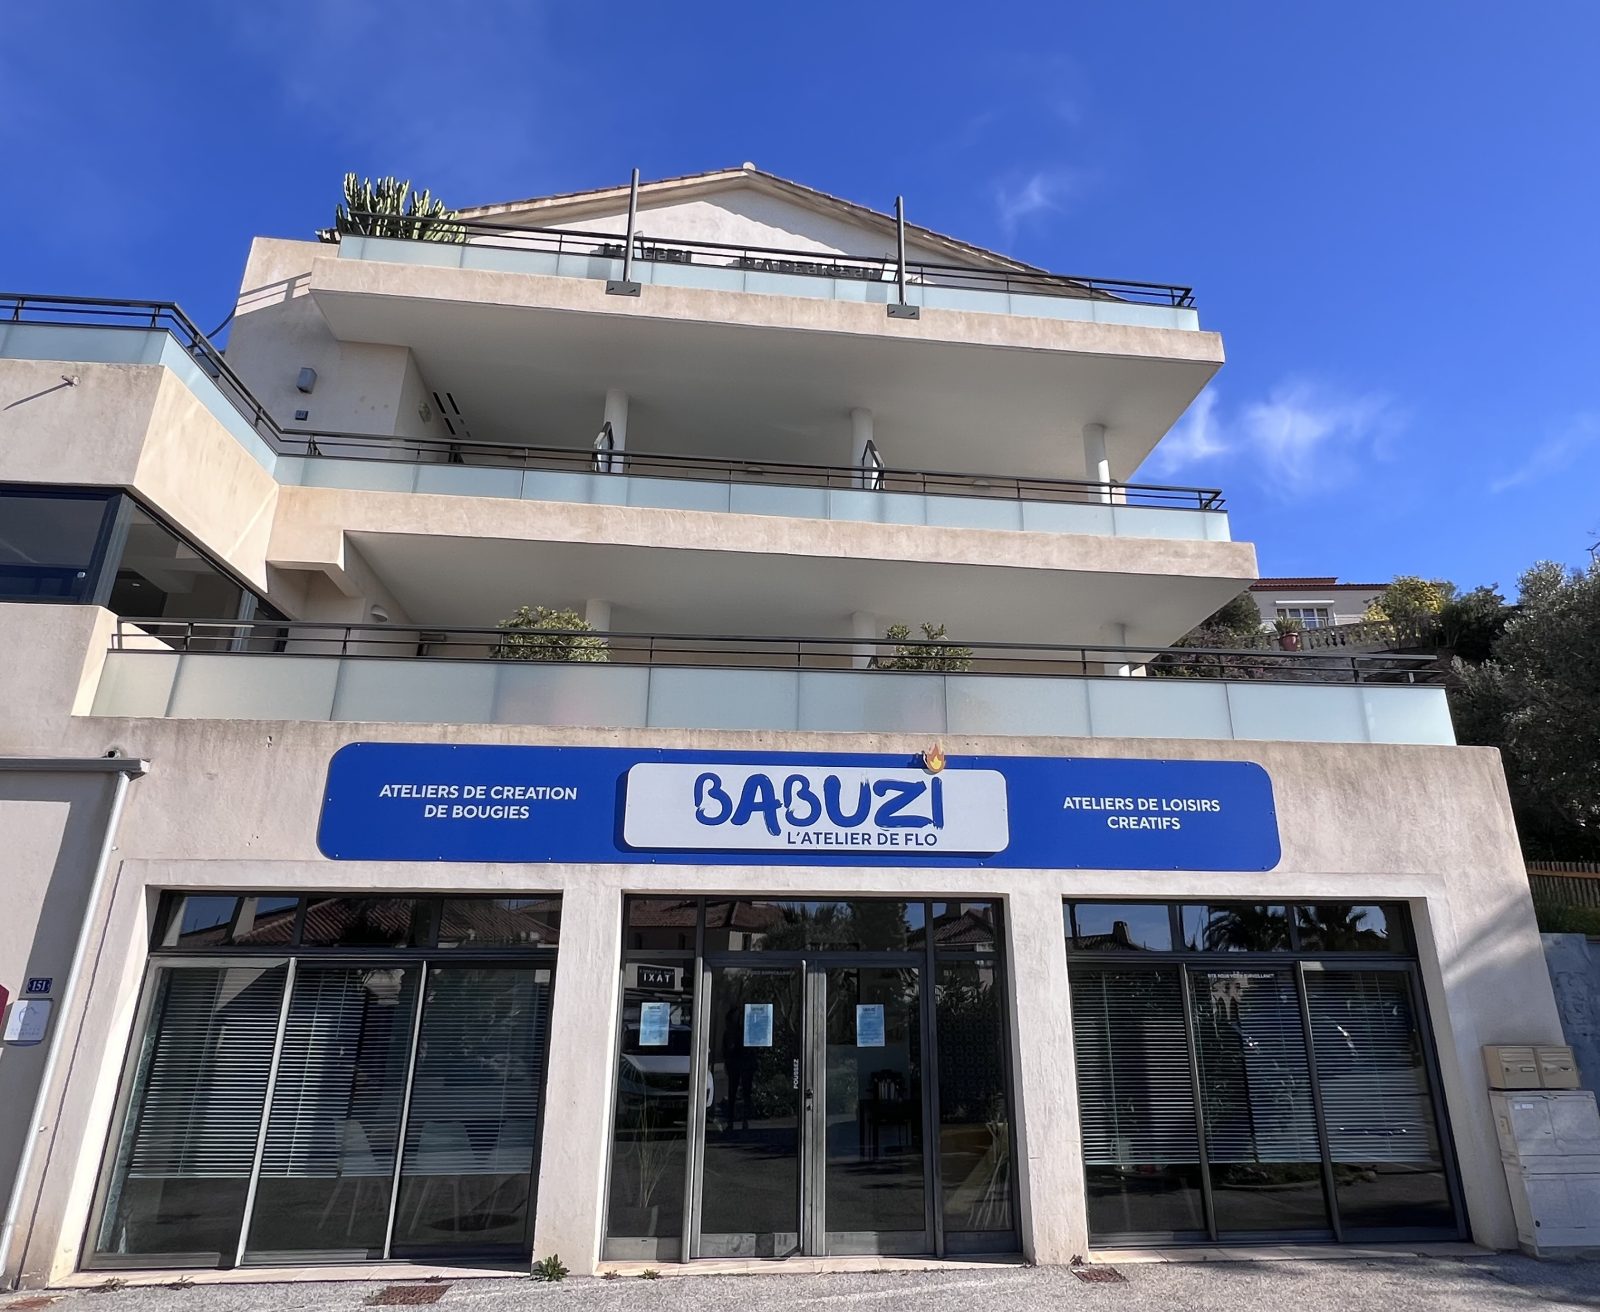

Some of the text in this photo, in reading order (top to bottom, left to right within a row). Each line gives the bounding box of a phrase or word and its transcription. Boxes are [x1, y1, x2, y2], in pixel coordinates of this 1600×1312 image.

[379, 784, 578, 800] ATELIERS DE CREATION
[424, 804, 530, 819] DE BOUGIES
[694, 772, 945, 837] BABUZI
[1063, 796, 1221, 812] ATELIERS DE LOISIRS
[1107, 816, 1181, 830] CREATIFS
[787, 831, 938, 847] L'ATELIER DE FLO
[31, 980, 47, 991] 151
